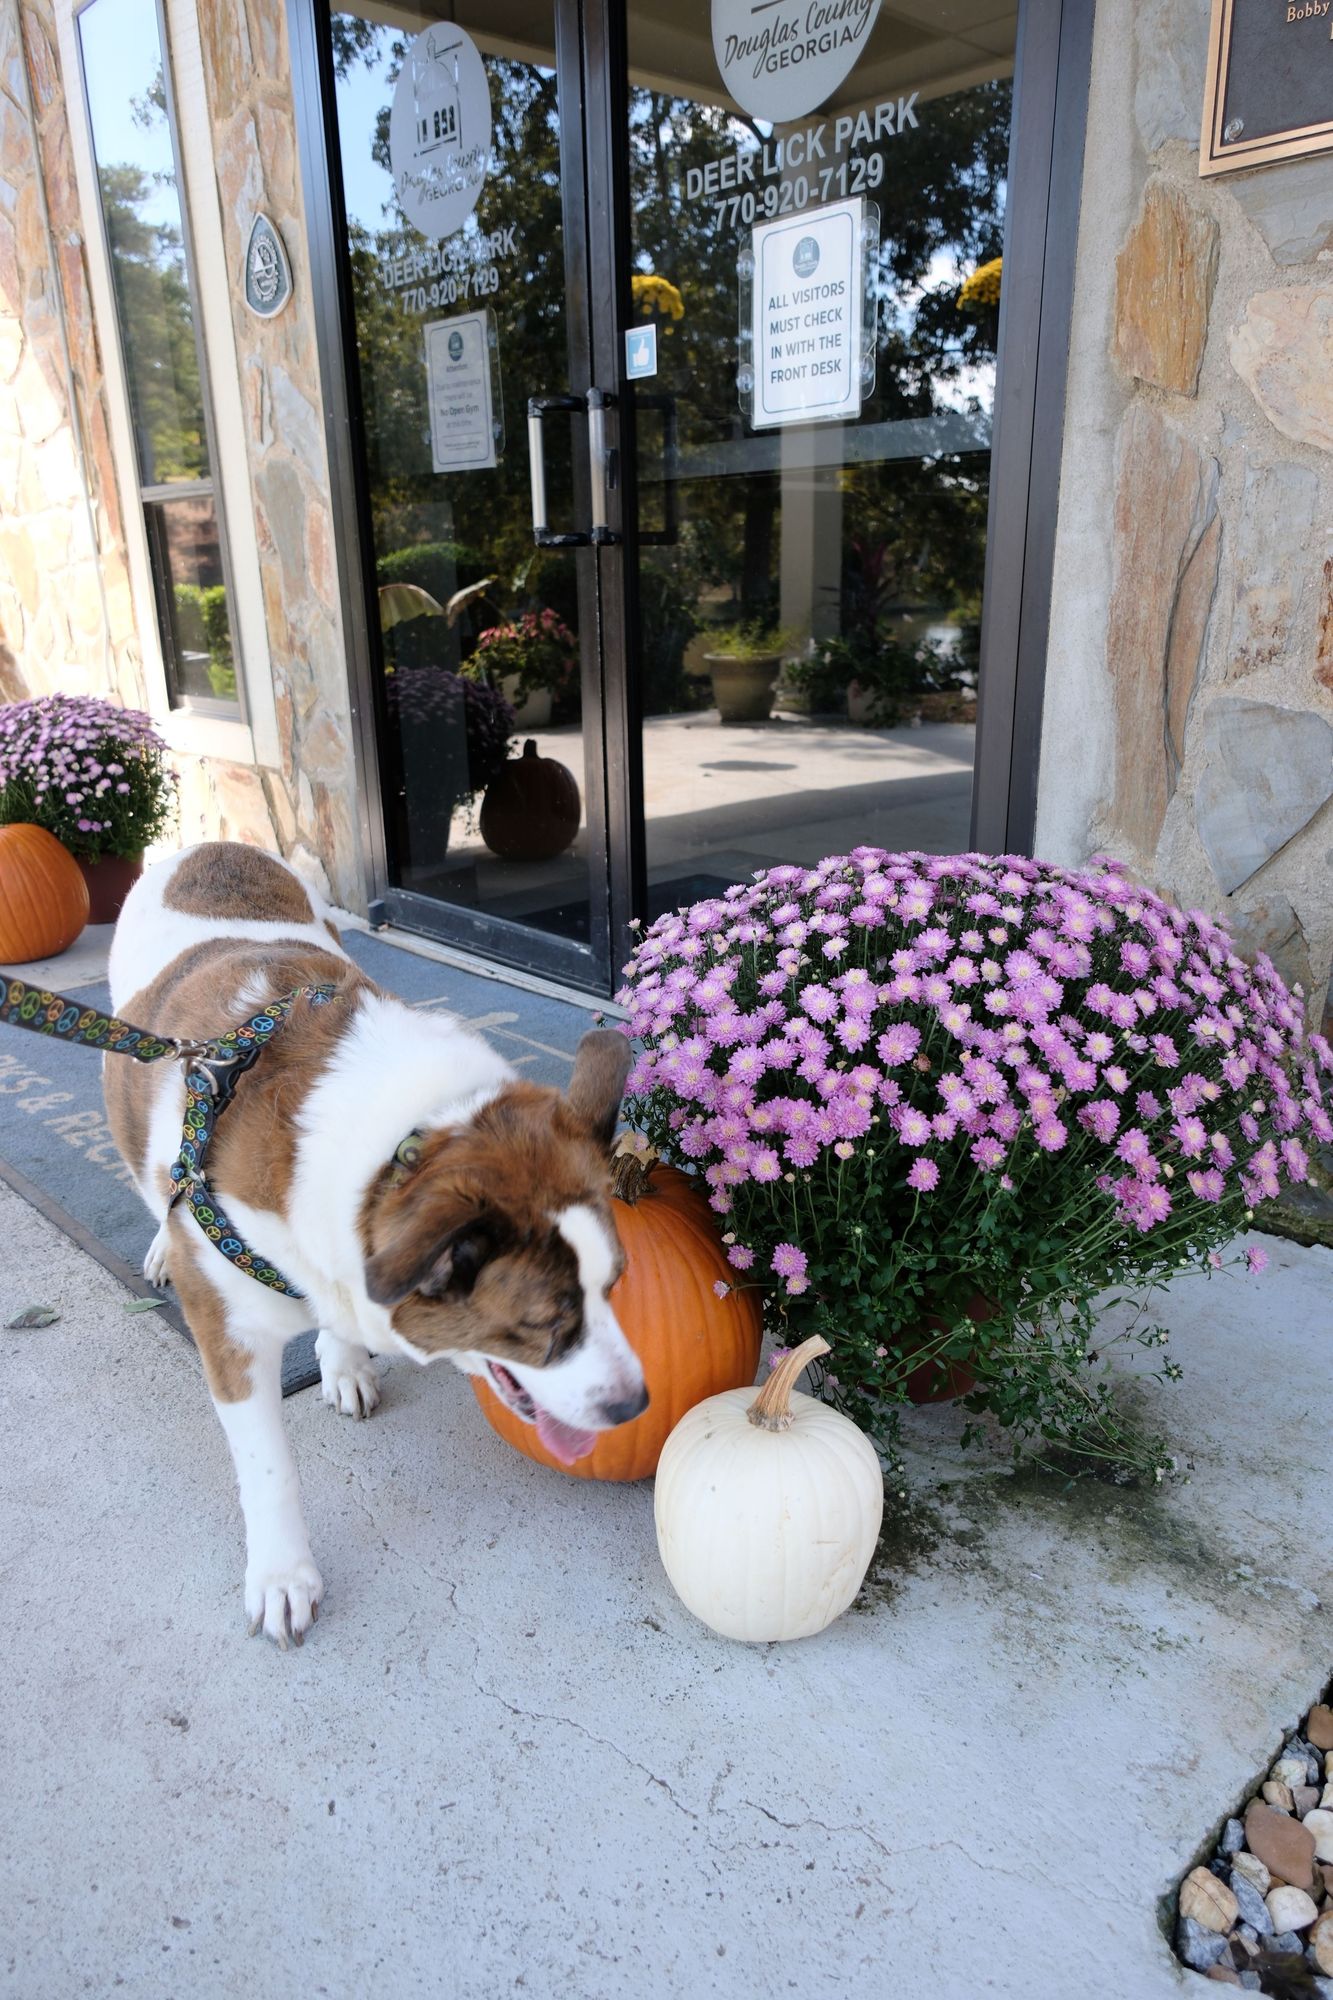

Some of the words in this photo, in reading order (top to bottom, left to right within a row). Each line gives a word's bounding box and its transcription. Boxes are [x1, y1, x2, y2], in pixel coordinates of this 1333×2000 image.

[1286, 0, 1331, 23] Bobby
[725, 15, 800, 79] Douglas
[806, 0, 873, 40] County
[765, 26, 854, 73] GEORGIA
[686, 151, 756, 200] DEER
[762, 123, 827, 177] LICK
[834, 91, 920, 154] PARK
[714, 152, 885, 231] 770-920-7129
[382, 254, 425, 290] DEER
[470, 226, 519, 262] PARK
[401, 267, 500, 315] 770-920-7129
[768, 294, 789, 311] ALL
[792, 280, 845, 305] VISITORS
[770, 316, 800, 335] MUST
[804, 307, 843, 328] CHECK
[771, 345, 782, 360] IN
[785, 338, 815, 357] WITH
[819, 333, 842, 350] THE
[771, 365, 807, 384] FRONT
[811, 359, 842, 377] DESK
